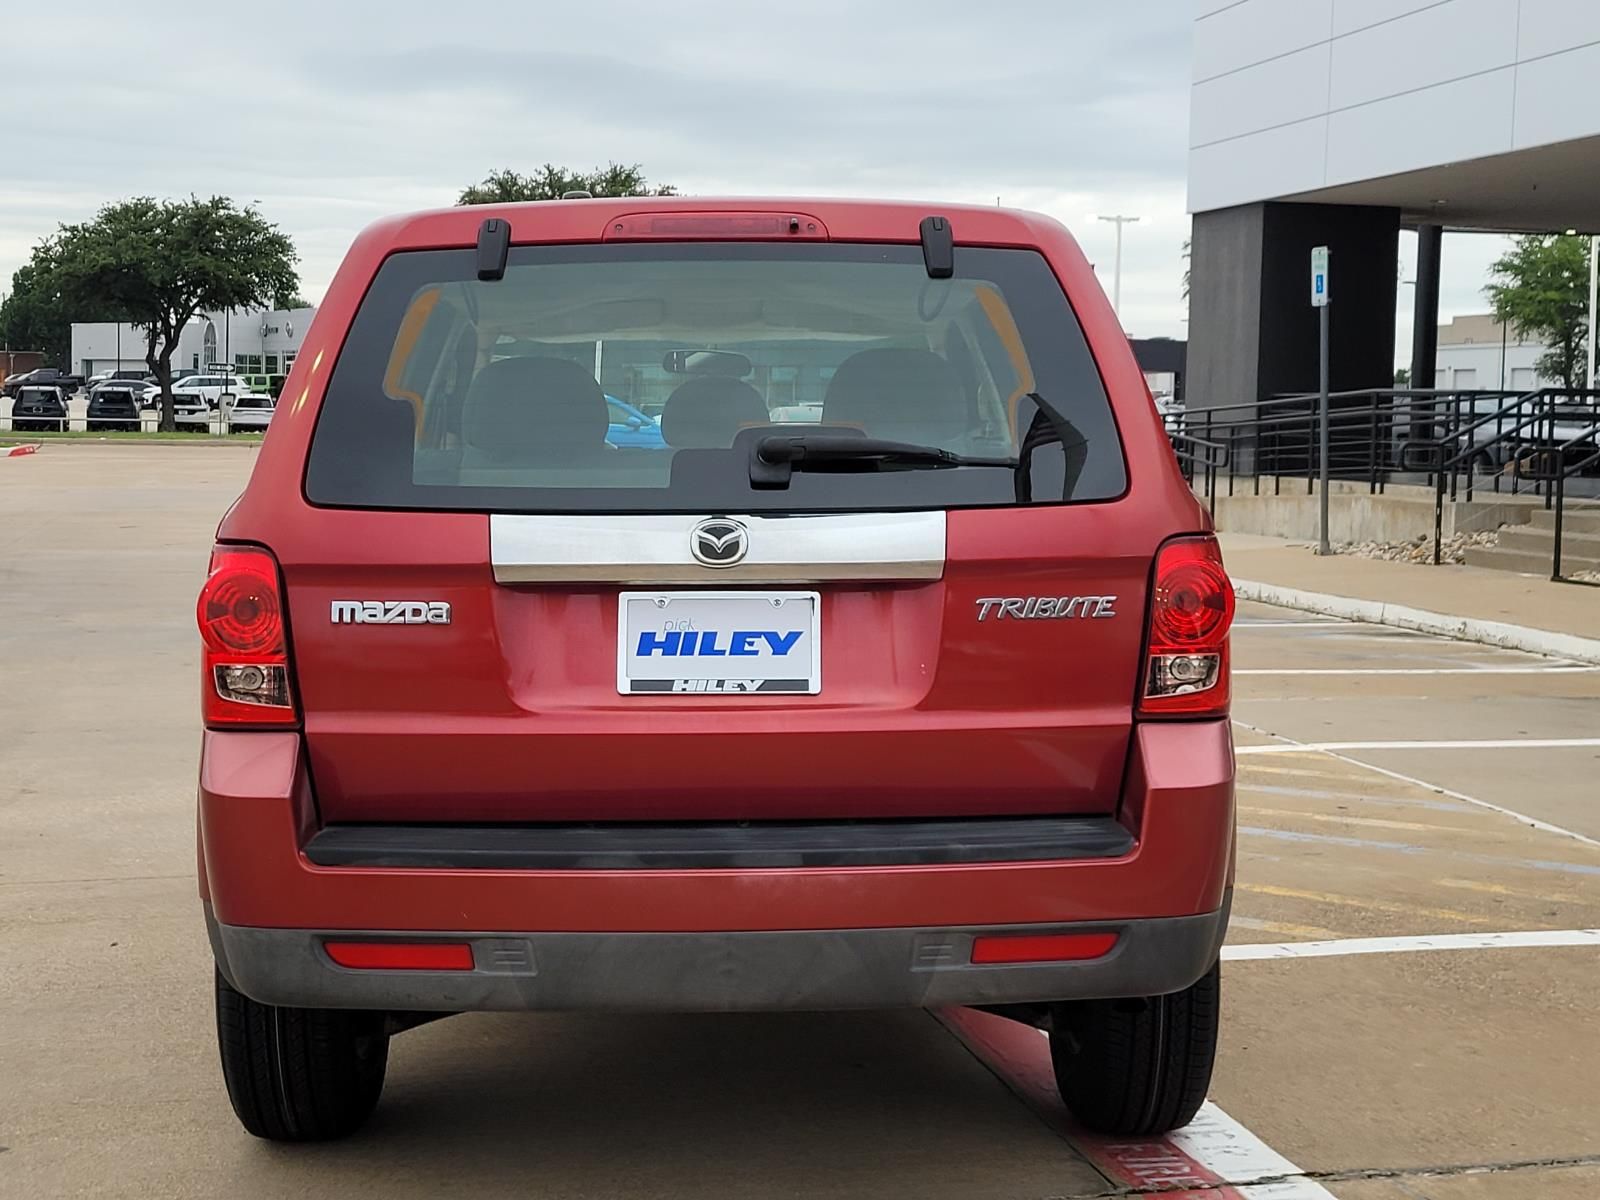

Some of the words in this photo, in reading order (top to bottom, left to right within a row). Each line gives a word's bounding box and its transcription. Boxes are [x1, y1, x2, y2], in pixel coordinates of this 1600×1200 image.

[976, 596, 1117, 621] TRIBUTE
[663, 617, 696, 633] pick
[636, 631, 804, 657] HILEY
[672, 679, 766, 692] HILEY
